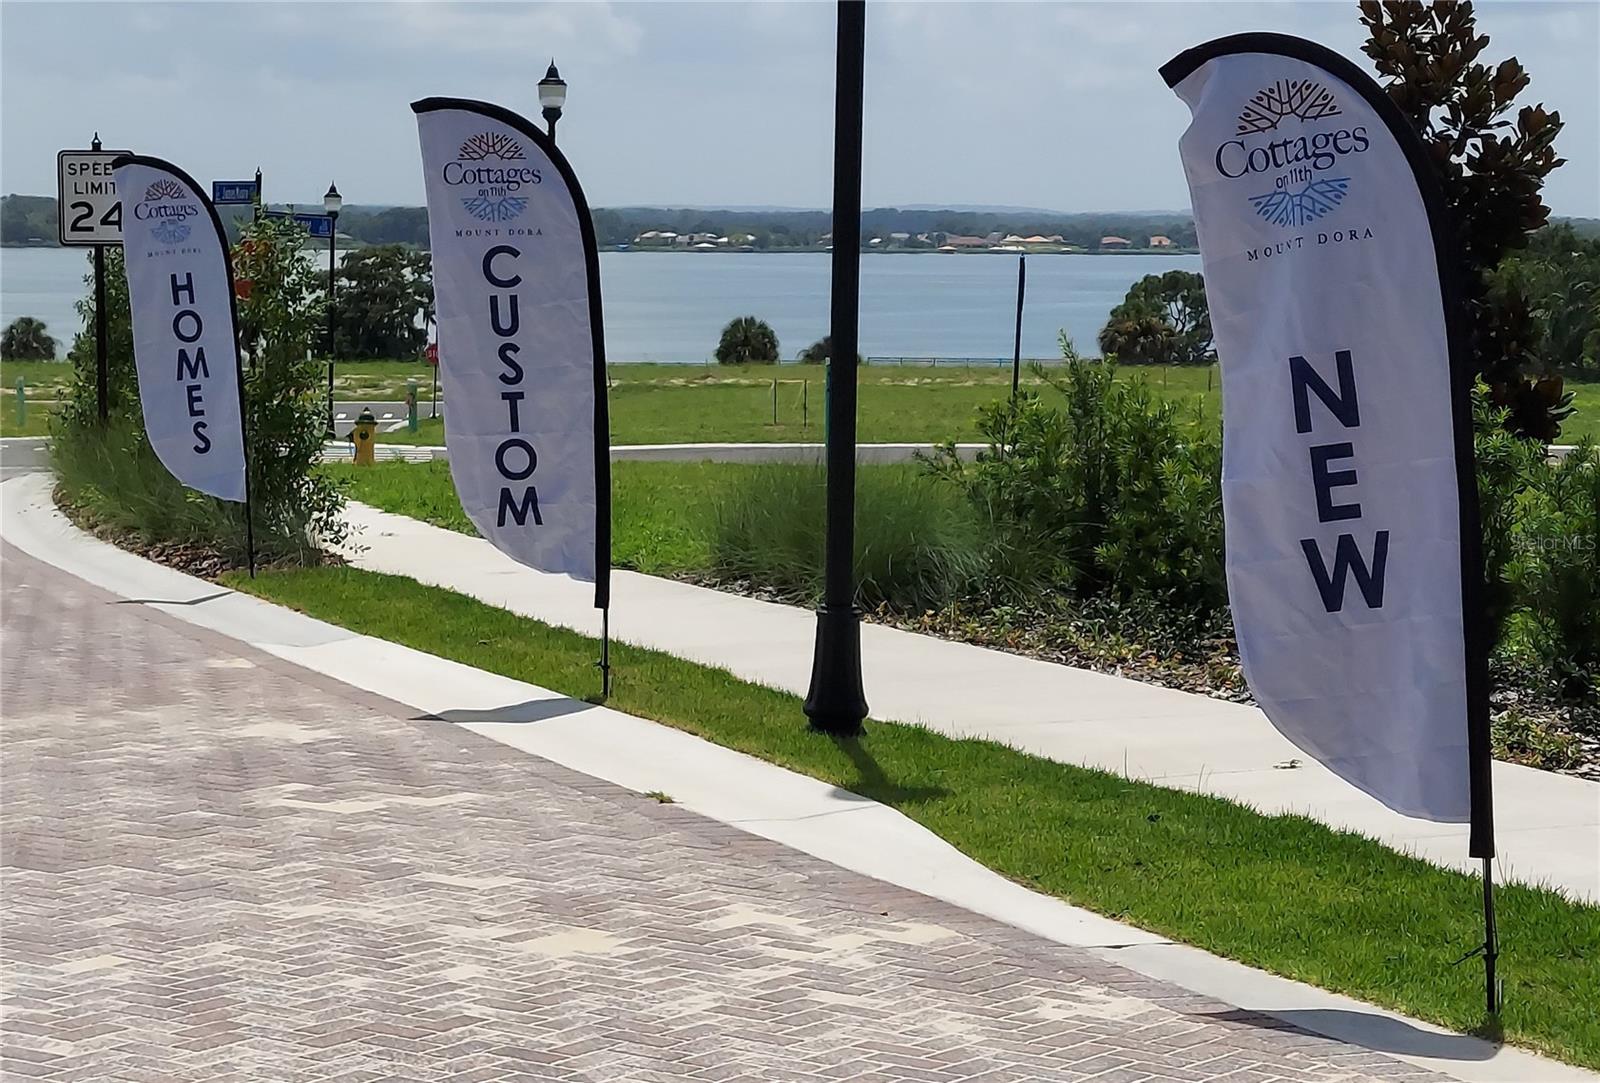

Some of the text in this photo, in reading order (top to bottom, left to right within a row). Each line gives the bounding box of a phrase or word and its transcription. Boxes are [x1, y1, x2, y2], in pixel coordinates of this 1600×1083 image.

[1215, 126, 1370, 179] Cottages
[67, 162, 113, 176] SPEE
[443, 161, 542, 191] Cottages
[1275, 175, 1289, 189] on
[70, 201, 123, 233] 24
[134, 202, 199, 222] Cottages
[455, 228, 543, 237] MOUNT DORA
[1247, 227, 1374, 262] MOUNT DORA
[170, 272, 212, 455] HOMES
[482, 244, 543, 527] CUSTOM
[1288, 349, 1390, 613] NEW
